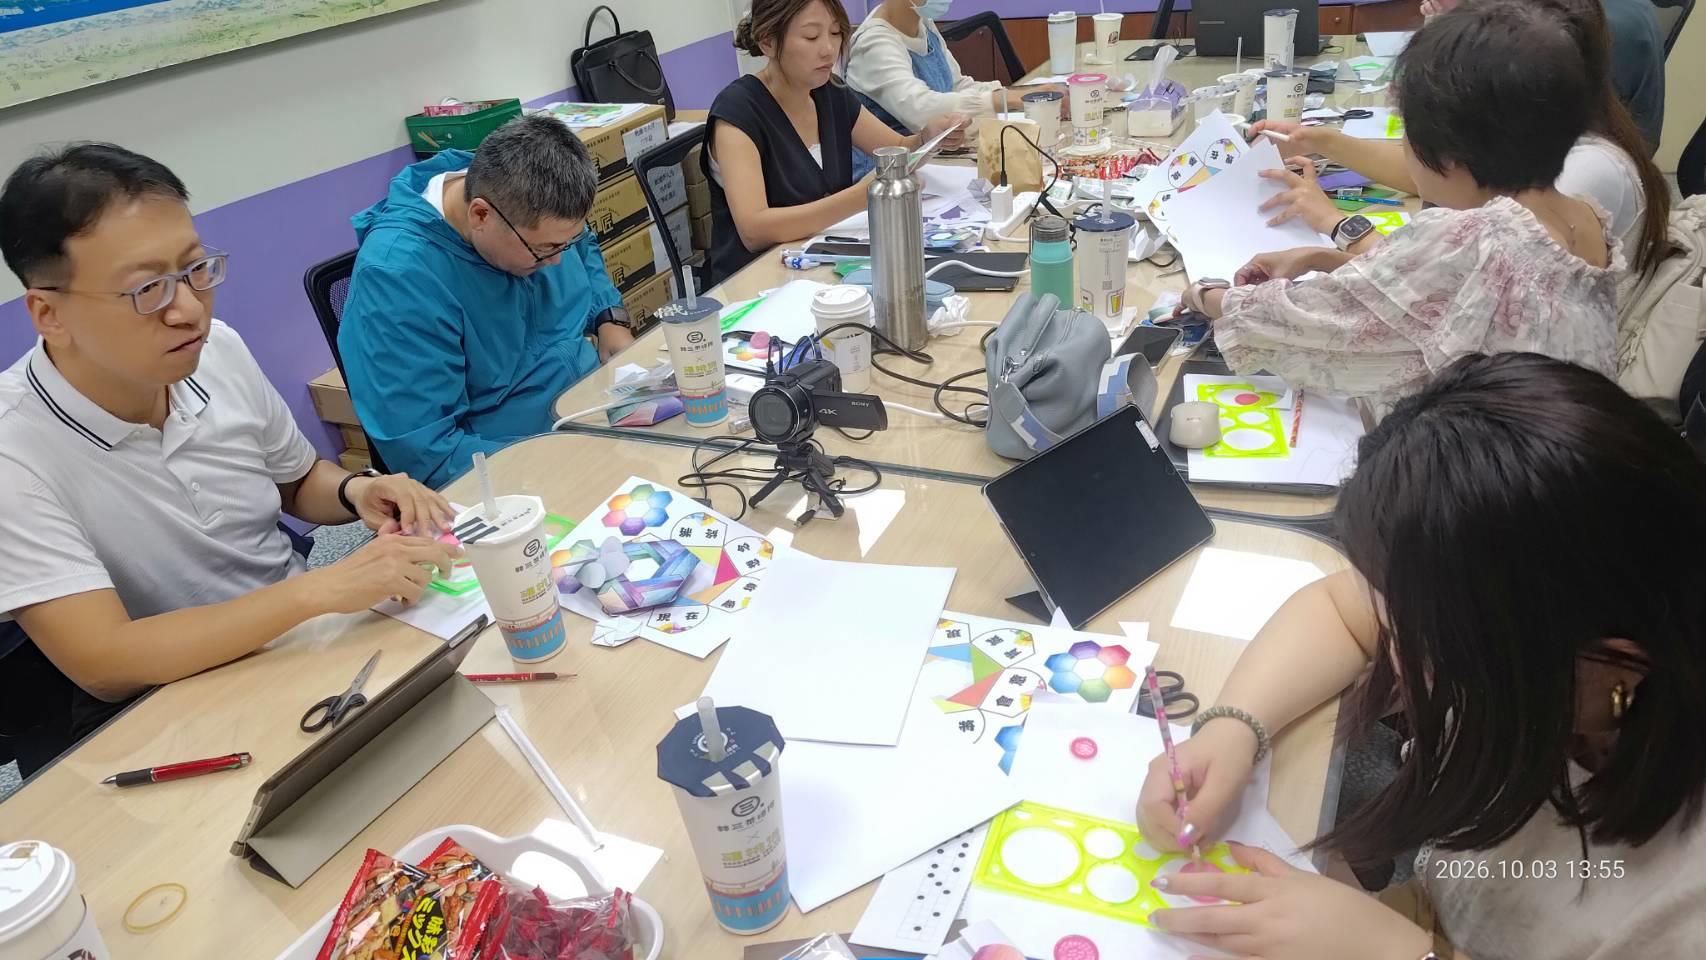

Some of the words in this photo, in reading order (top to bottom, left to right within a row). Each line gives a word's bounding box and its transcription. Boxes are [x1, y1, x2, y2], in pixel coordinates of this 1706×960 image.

[1210, 150, 1235, 165] 現在
[818, 408, 838, 416] 4K
[678, 526, 720, 540] 終將
[656, 611, 700, 622] 現在
[420, 915, 445, 954] 味彩
